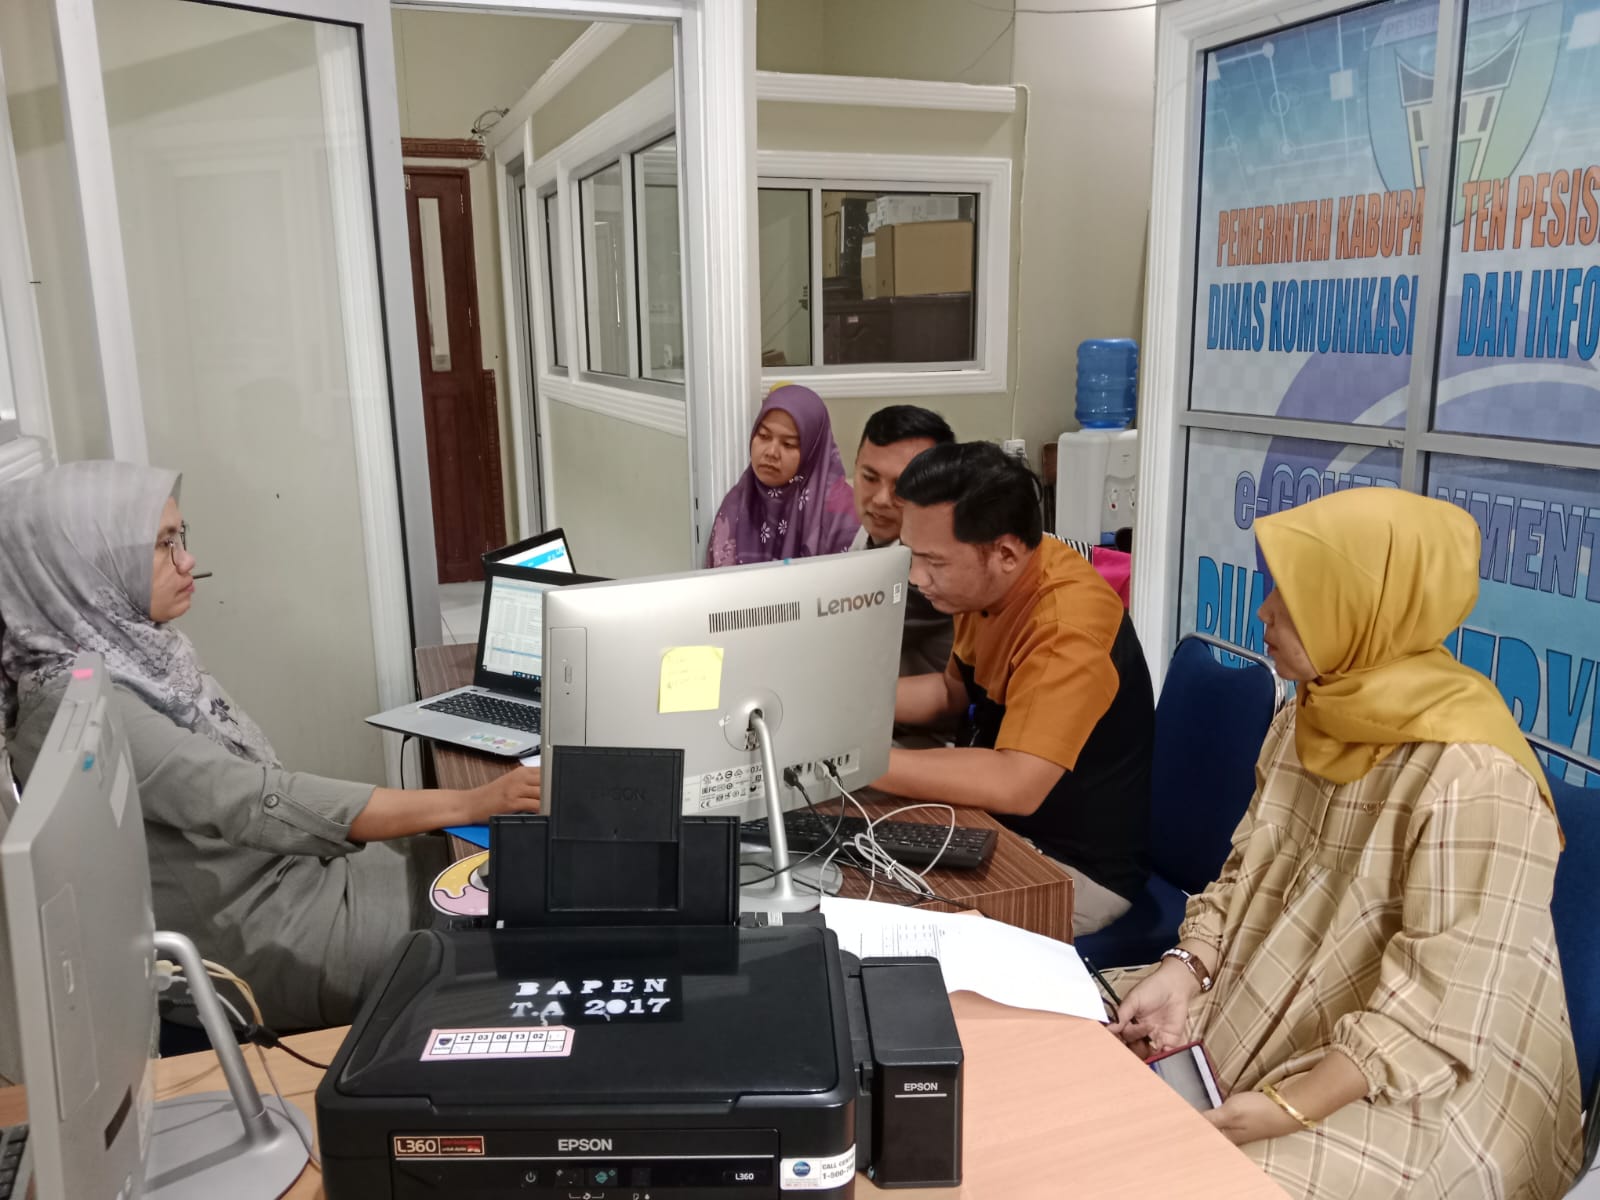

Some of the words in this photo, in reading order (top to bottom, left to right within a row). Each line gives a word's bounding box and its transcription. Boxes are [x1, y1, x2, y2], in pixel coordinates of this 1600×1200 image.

[1217, 197, 1333, 267] PEMERINTAH
[1513, 164, 1600, 249] PESIS
[1207, 281, 1266, 352] DINAS
[1269, 274, 1419, 356] KOMUNIKASI
[1457, 271, 1522, 357] DAN
[1524, 265, 1600, 361] INFO
[817, 590, 885, 617] Lenovo
[515, 978, 668, 996] BAPEN
[584, 997, 671, 1016] 2017
[904, 1082, 938, 1091] EPSON
[397, 1139, 436, 1153] L360
[558, 1138, 612, 1151] EPSON
[735, 1172, 754, 1180] L360
